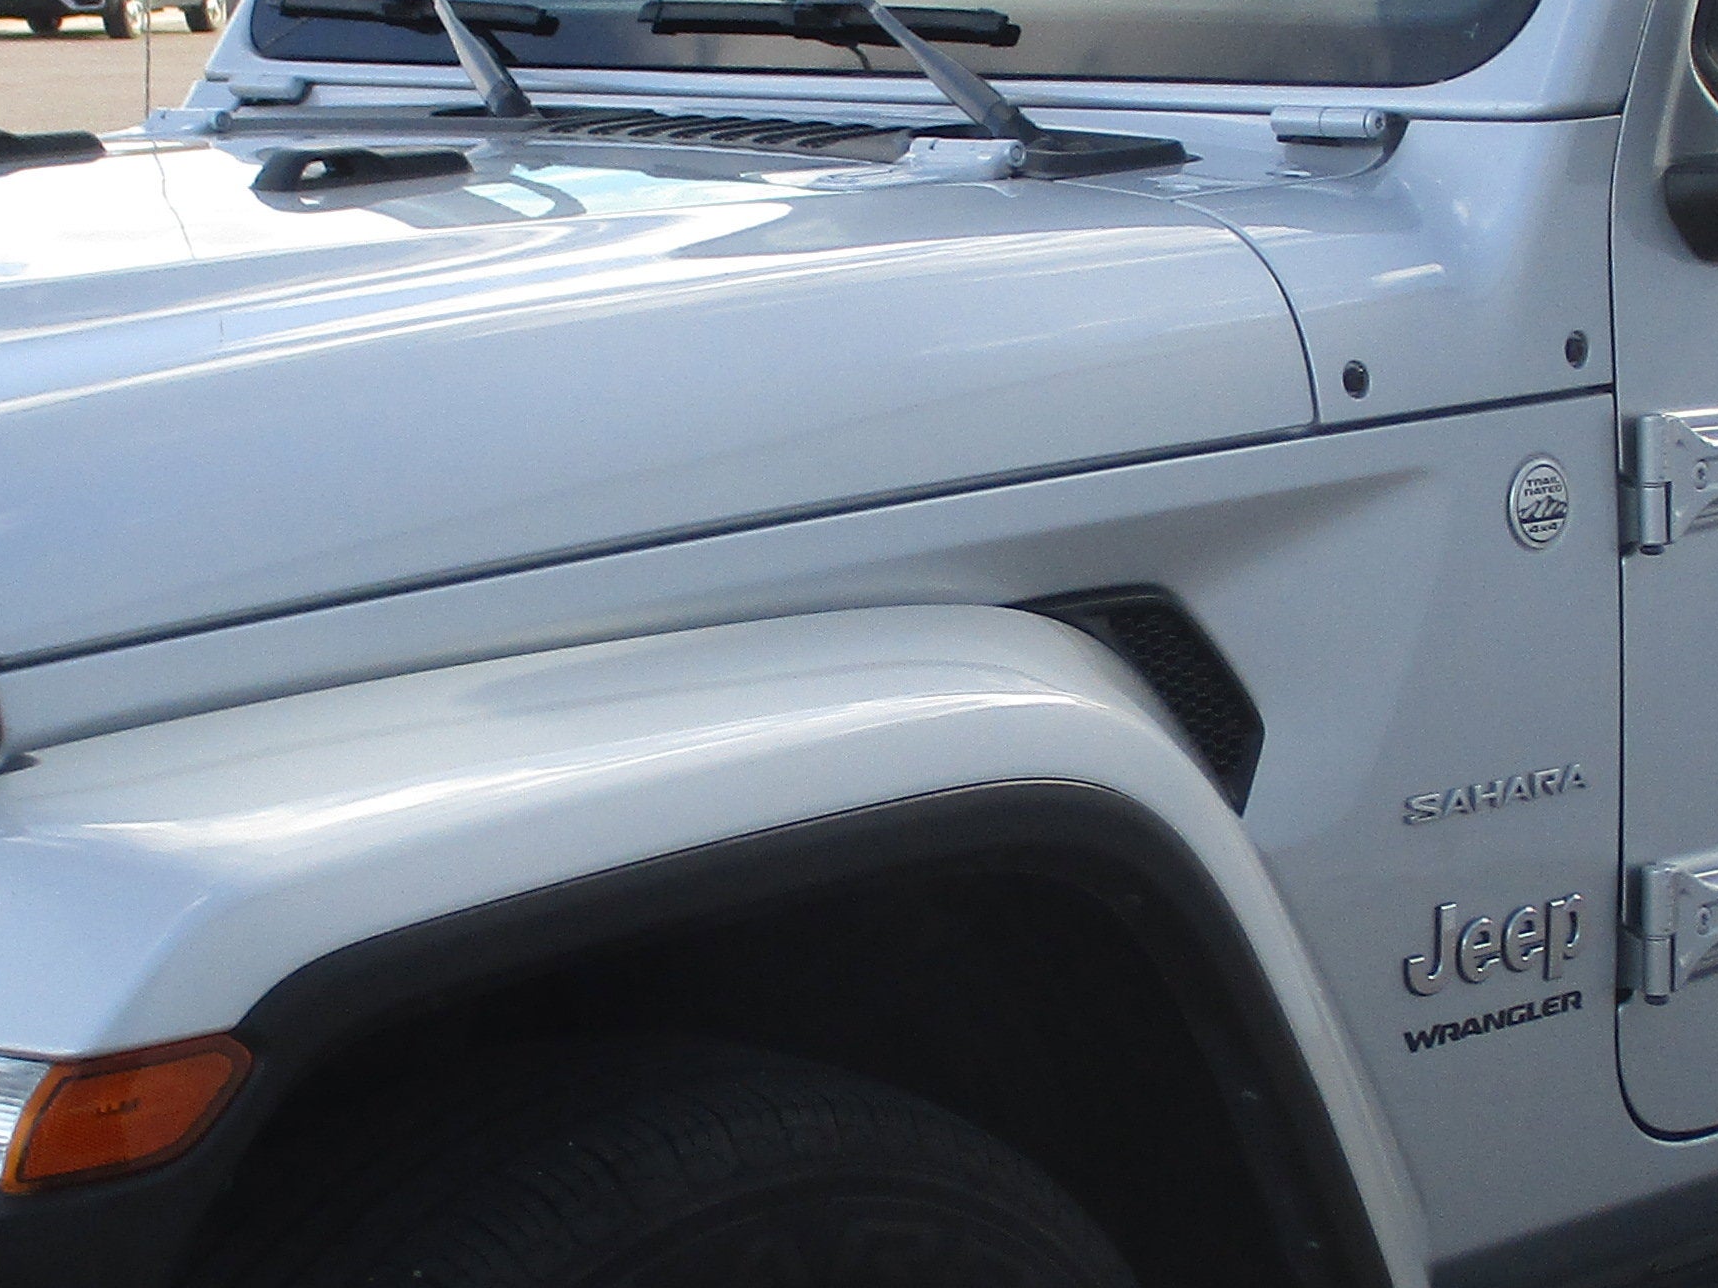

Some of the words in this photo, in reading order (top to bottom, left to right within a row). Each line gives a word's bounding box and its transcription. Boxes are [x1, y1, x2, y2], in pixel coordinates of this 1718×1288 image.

[1403, 763, 1586, 825] SAHARA
[1403, 892, 1583, 997] Jeep
[1404, 990, 1583, 1053] WRANGLER
